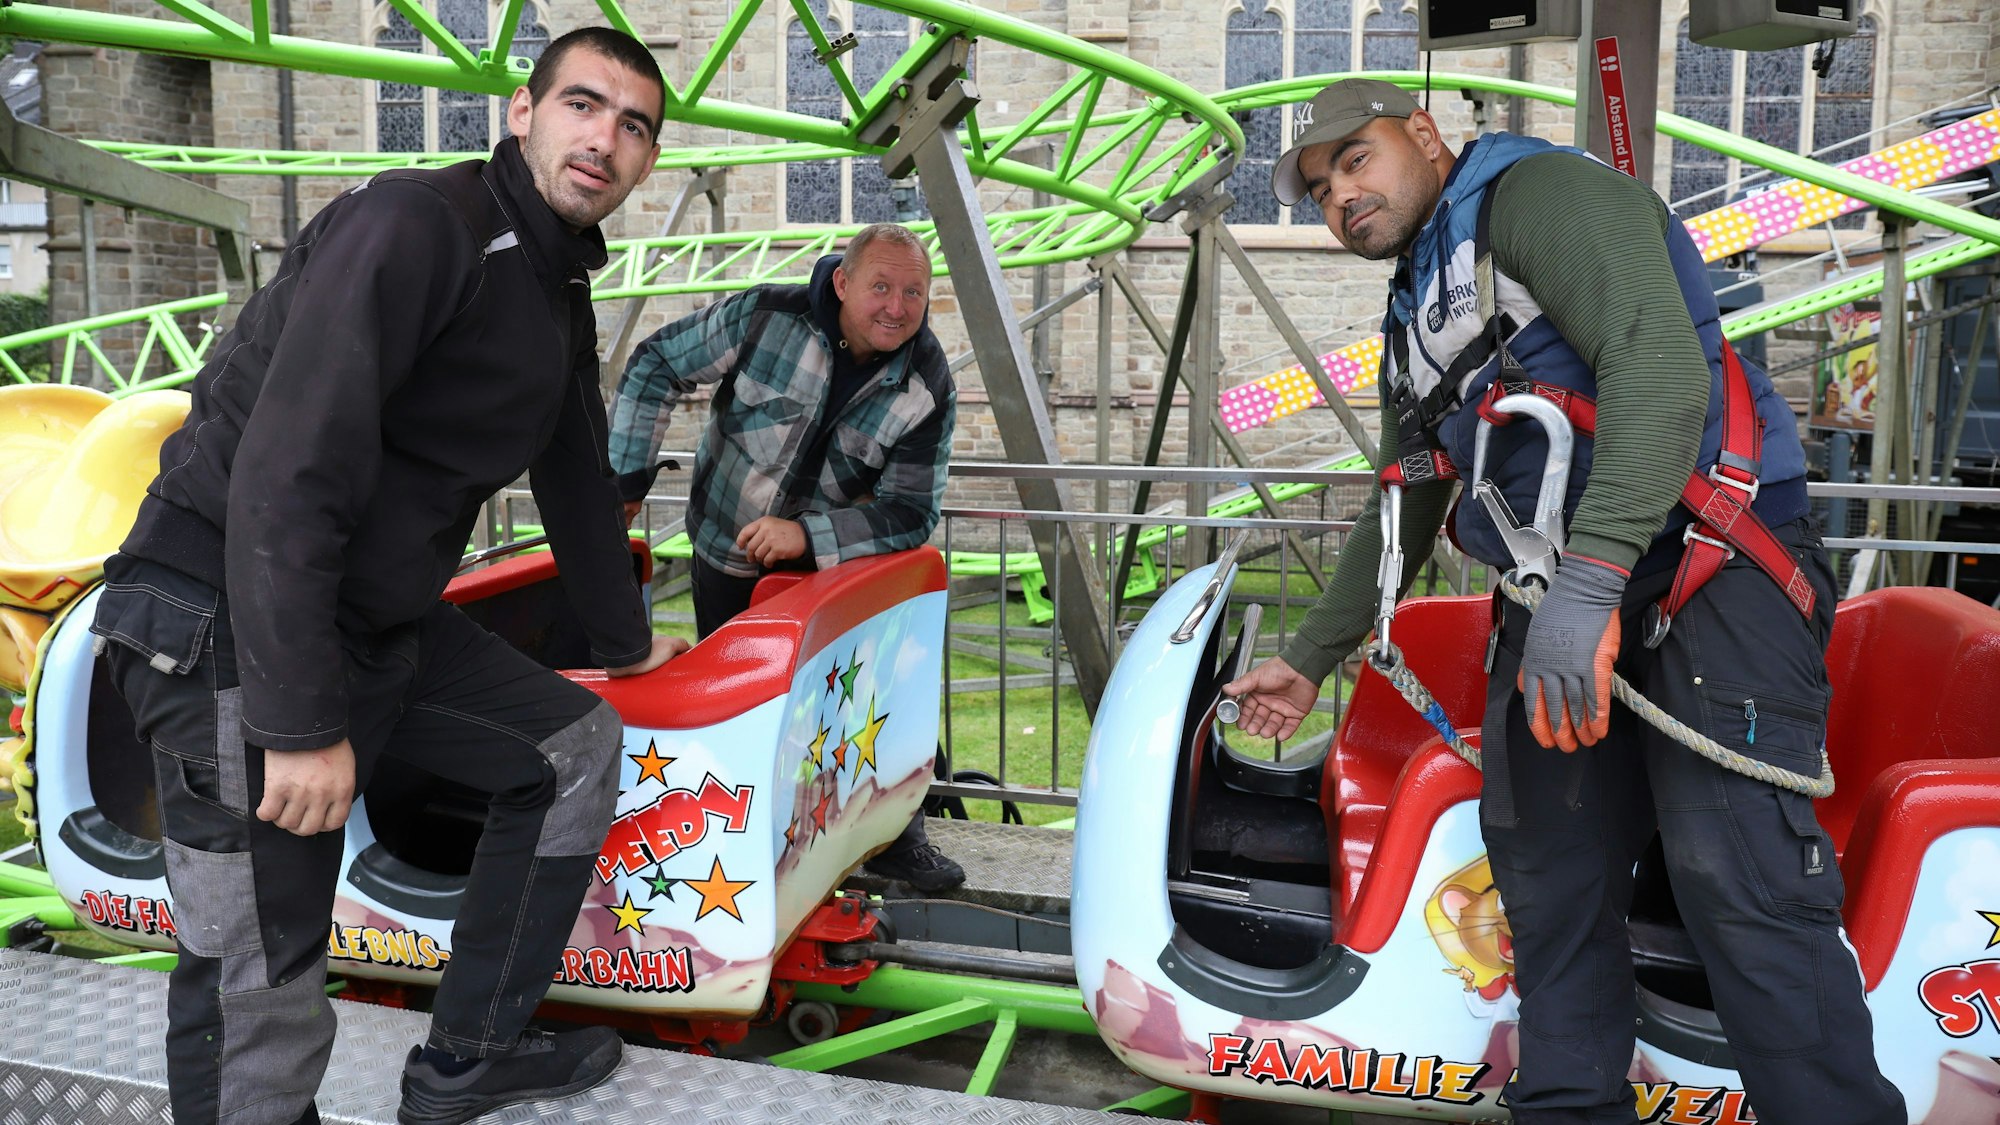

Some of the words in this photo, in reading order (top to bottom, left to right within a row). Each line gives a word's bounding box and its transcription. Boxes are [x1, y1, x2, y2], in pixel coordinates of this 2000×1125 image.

[1609, 95, 1629, 156] Abstand
[1447, 280, 1477, 305] BRK
[590, 771, 755, 886] PEEDY
[81, 889, 138, 932] DIE
[134, 897, 177, 938] FA
[327, 921, 452, 971] LEBNIS-
[1206, 1033, 1491, 1106] FAMILIE
[1628, 1082, 1759, 1125] VEL
